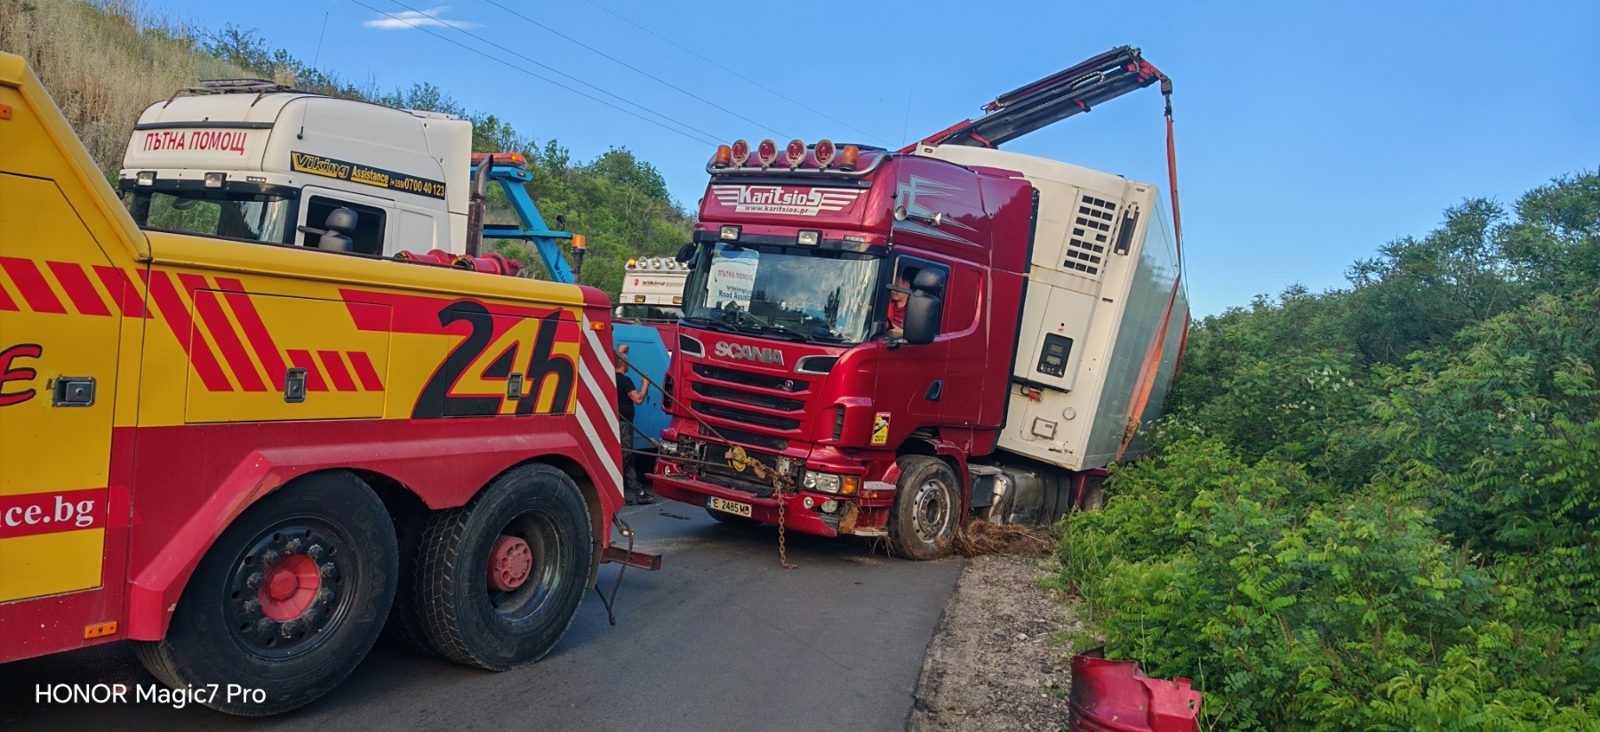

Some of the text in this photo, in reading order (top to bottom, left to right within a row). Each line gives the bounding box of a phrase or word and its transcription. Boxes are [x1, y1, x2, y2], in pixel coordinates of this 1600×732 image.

[143, 131, 247, 156] ПЪТНА ПОМОЩ
[294, 153, 389, 184] Viking Assistance
[404, 177, 423, 192] 0700
[423, 181, 432, 194] 40
[433, 184, 445, 197] 123
[745, 205, 809, 215] www.karitsios.gr
[410, 299, 576, 420] 24h
[714, 341, 785, 366] SCANIA
[0, 495, 95, 527] ce.bg
